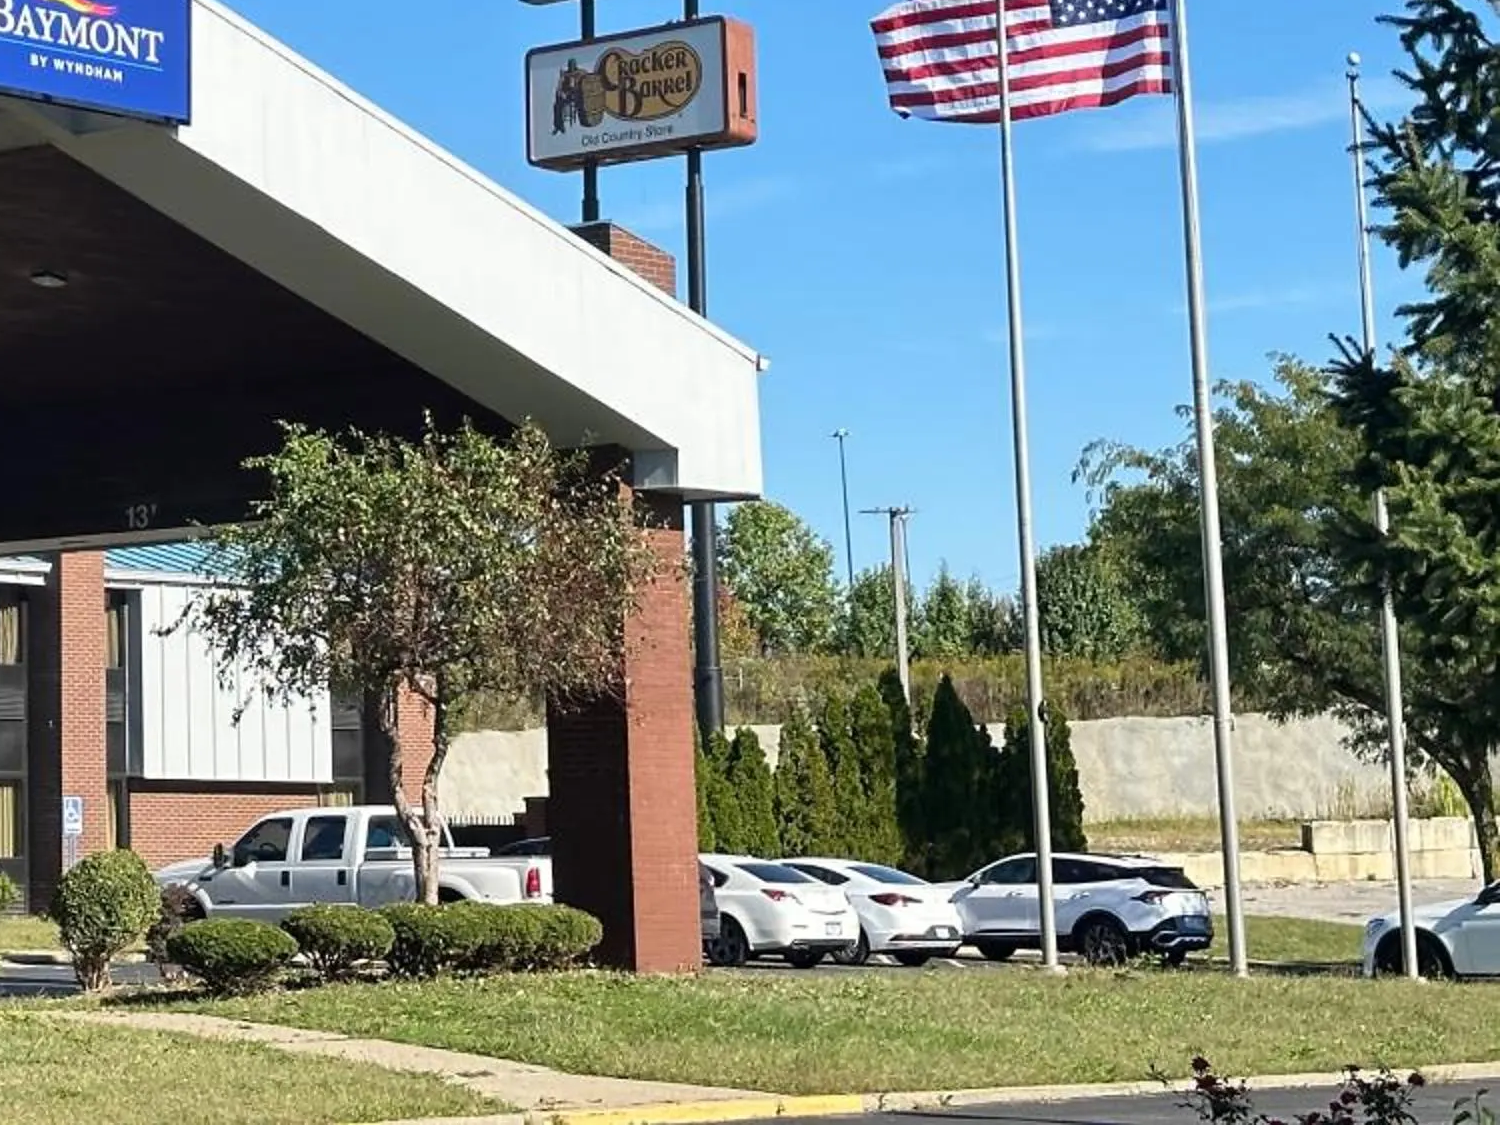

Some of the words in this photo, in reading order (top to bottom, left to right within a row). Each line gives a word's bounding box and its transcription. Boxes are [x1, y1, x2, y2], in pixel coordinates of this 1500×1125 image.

[30, 54, 48, 67] BY
[53, 58, 124, 83] WYNDHAM
[582, 134, 600, 147] Old
[602, 127, 642, 144] Country
